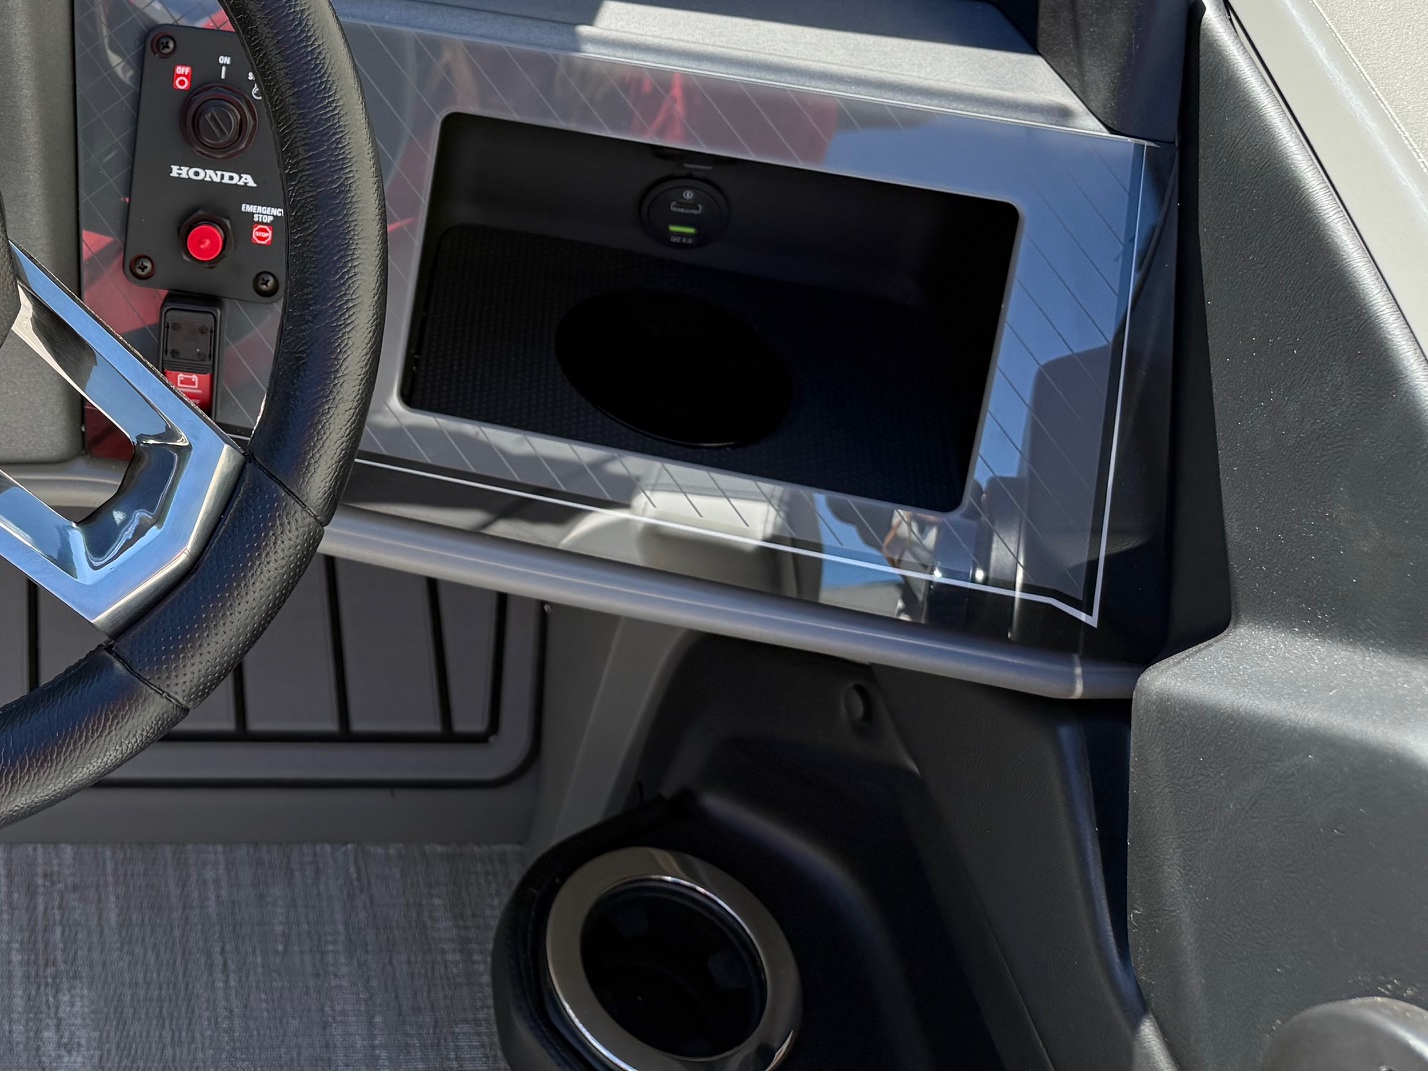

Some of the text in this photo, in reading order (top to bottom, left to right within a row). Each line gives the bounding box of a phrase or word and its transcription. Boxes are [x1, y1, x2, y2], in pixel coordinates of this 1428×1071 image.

[218, 55, 232, 65] ON
[175, 65, 192, 76] OFF
[169, 165, 258, 187] HONDA
[253, 214, 274, 224] STOP
